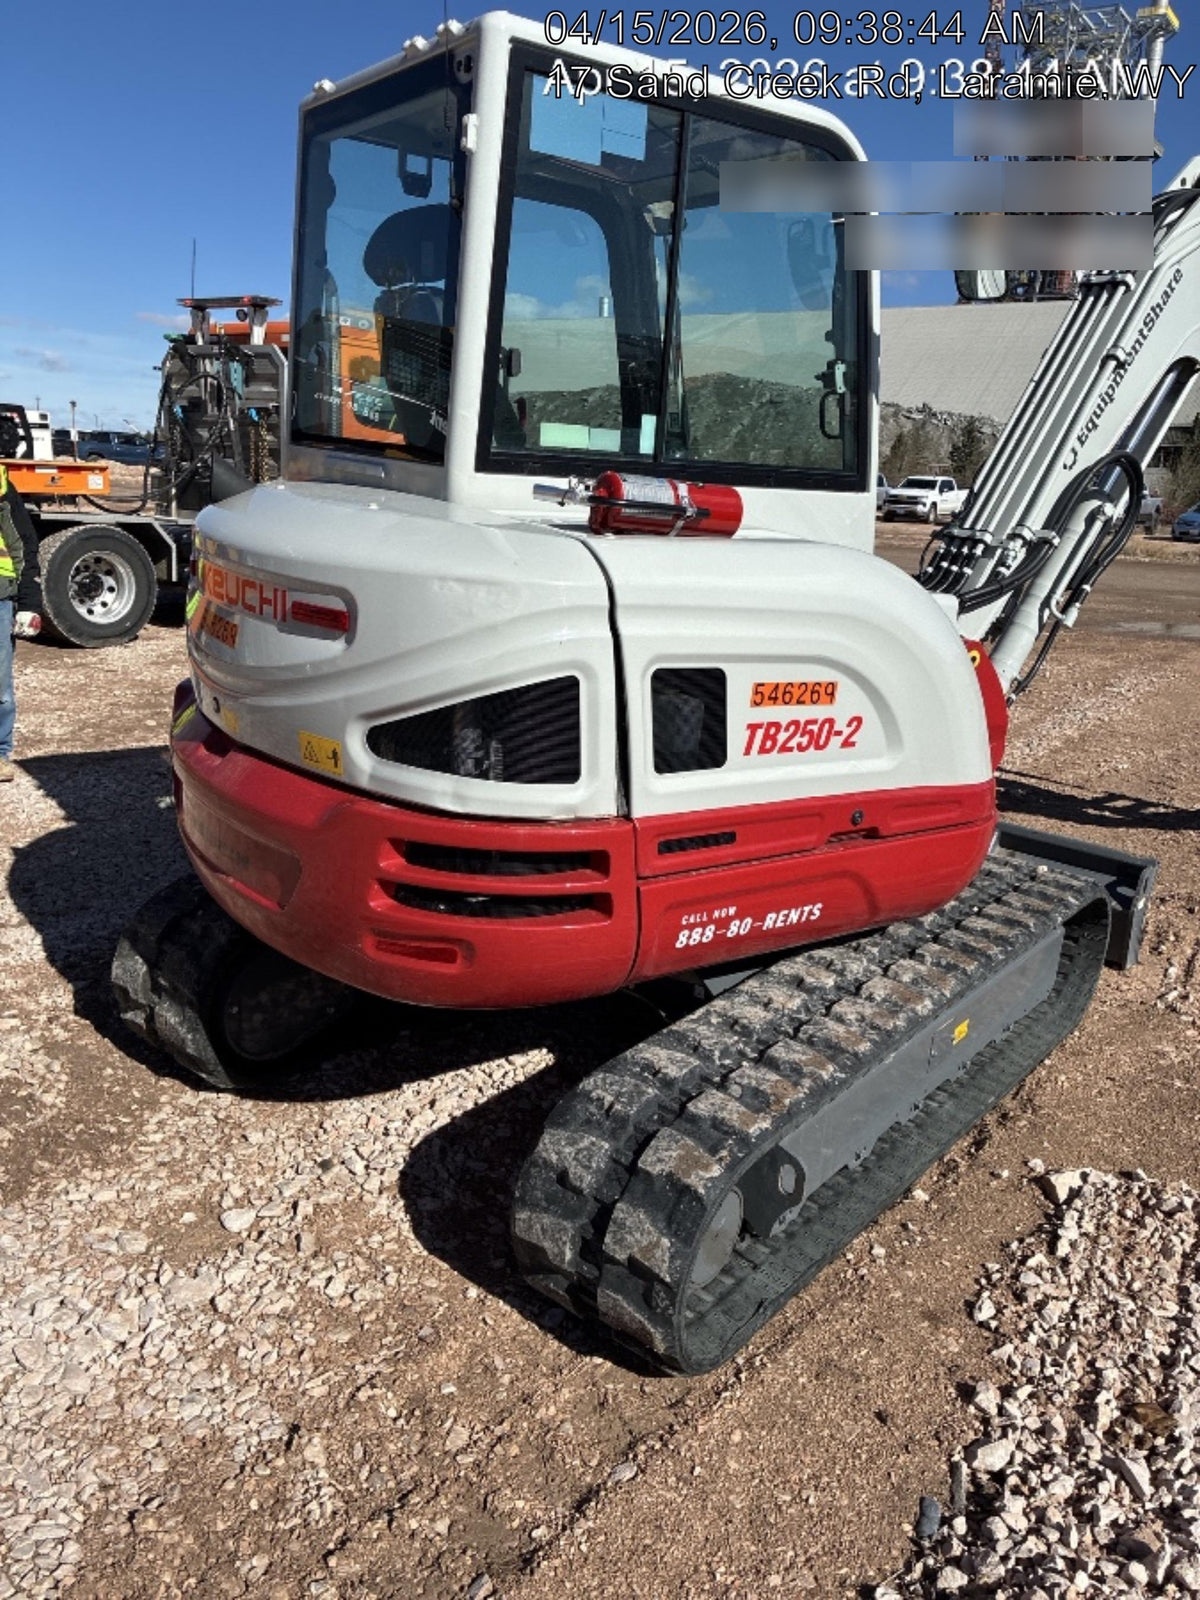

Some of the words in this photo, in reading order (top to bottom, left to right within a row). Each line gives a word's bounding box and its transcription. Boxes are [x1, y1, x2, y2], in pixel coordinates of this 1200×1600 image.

[753, 682, 835, 706] 546269
[743, 716, 863, 756] TB250-2
[675, 903, 823, 948] 888-80-RENTS
[681, 914, 708, 925] CALL
[713, 906, 737, 919] NOW
